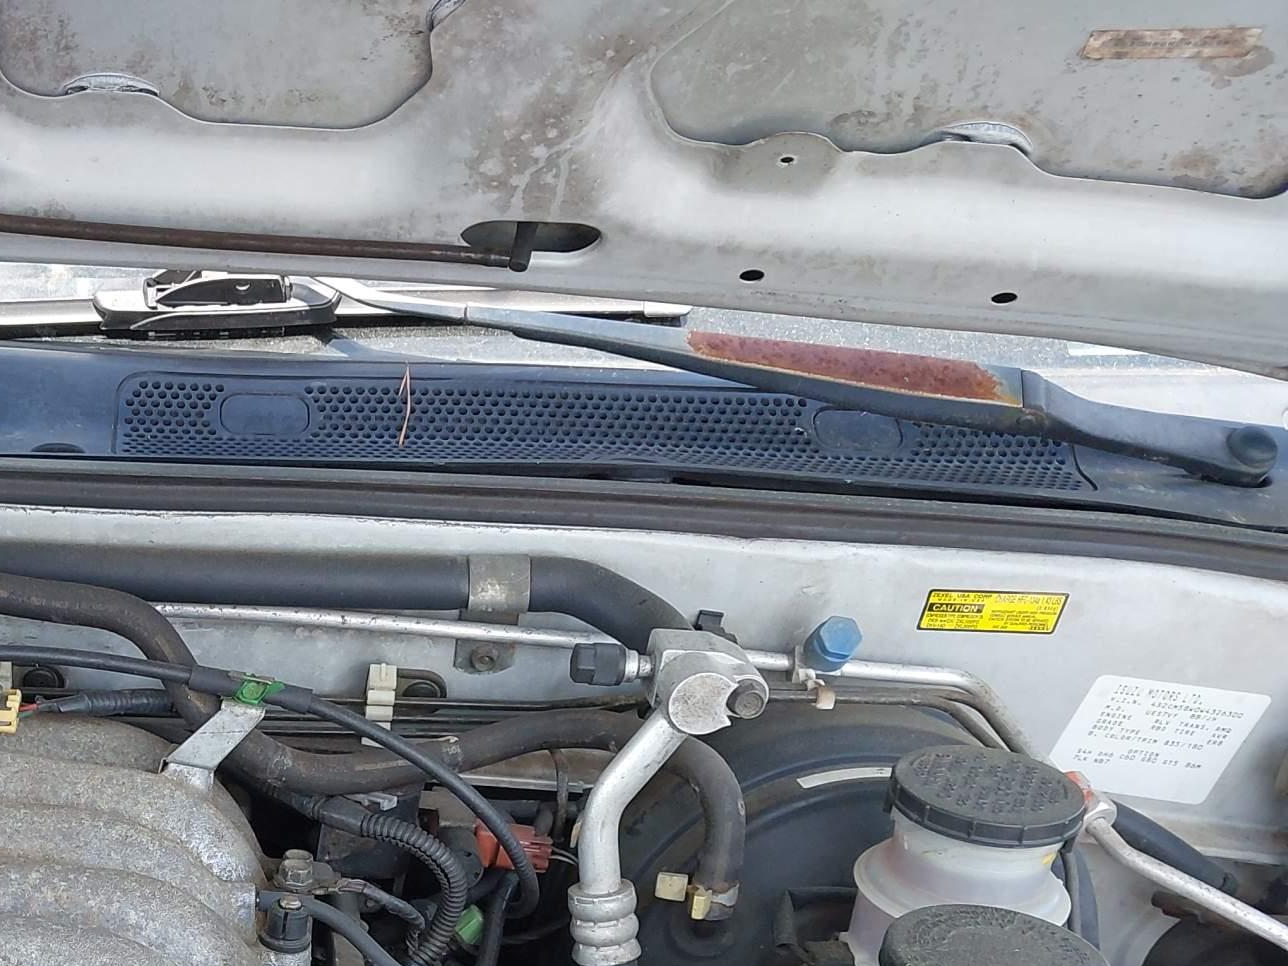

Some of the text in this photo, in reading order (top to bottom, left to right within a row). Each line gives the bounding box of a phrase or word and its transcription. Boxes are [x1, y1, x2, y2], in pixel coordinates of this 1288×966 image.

[932, 603, 979, 613] CAUTION
[1092, 724, 1114, 732] BODY
[1120, 727, 1141, 736] TYPE
